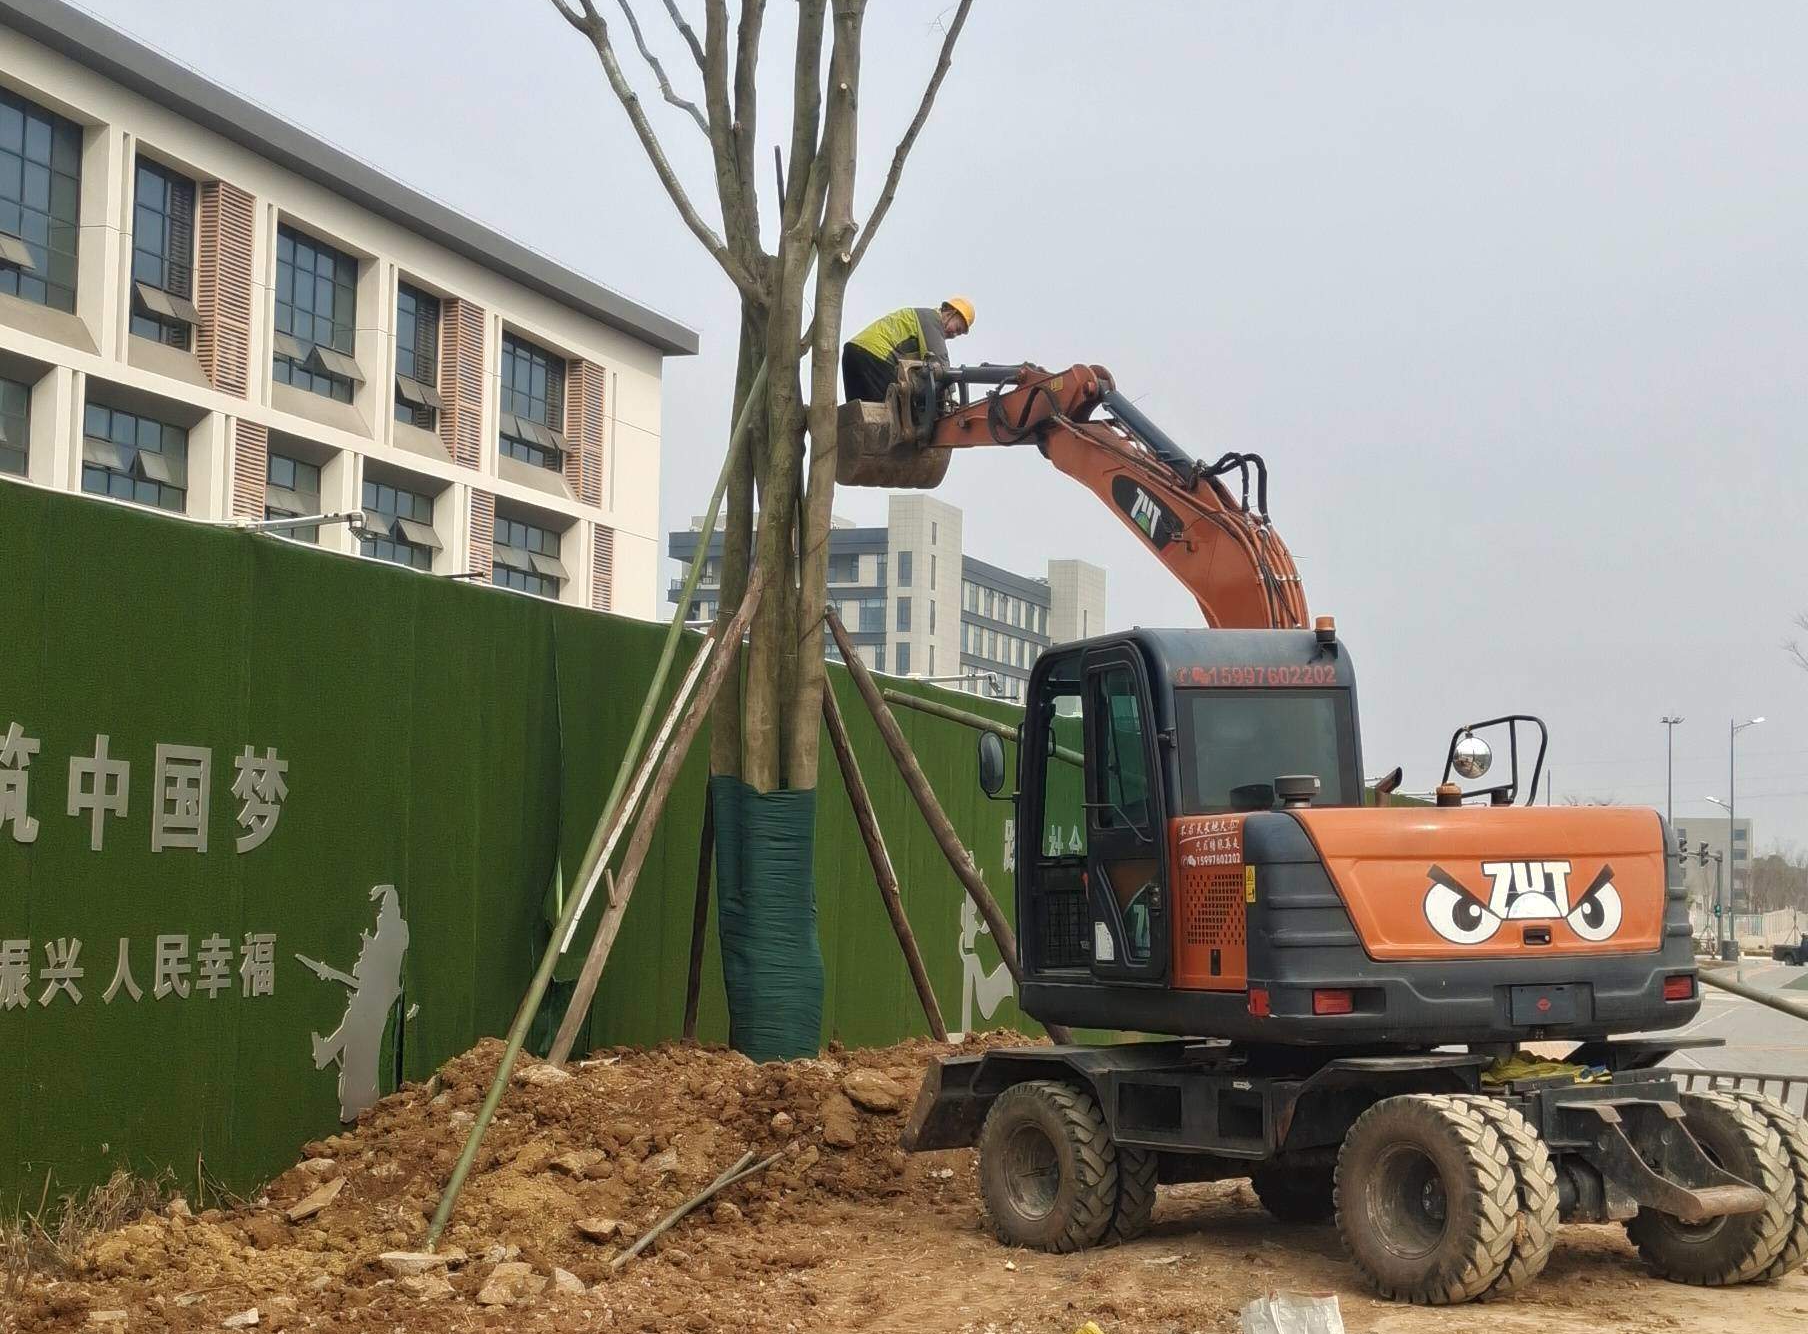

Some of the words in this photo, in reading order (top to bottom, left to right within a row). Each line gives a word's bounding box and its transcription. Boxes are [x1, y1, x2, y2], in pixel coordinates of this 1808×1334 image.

[1211, 665, 1337, 685] 15997602202
[0, 937, 84, 1009] 振兴
[103, 932, 277, 1005] 人民幸福
